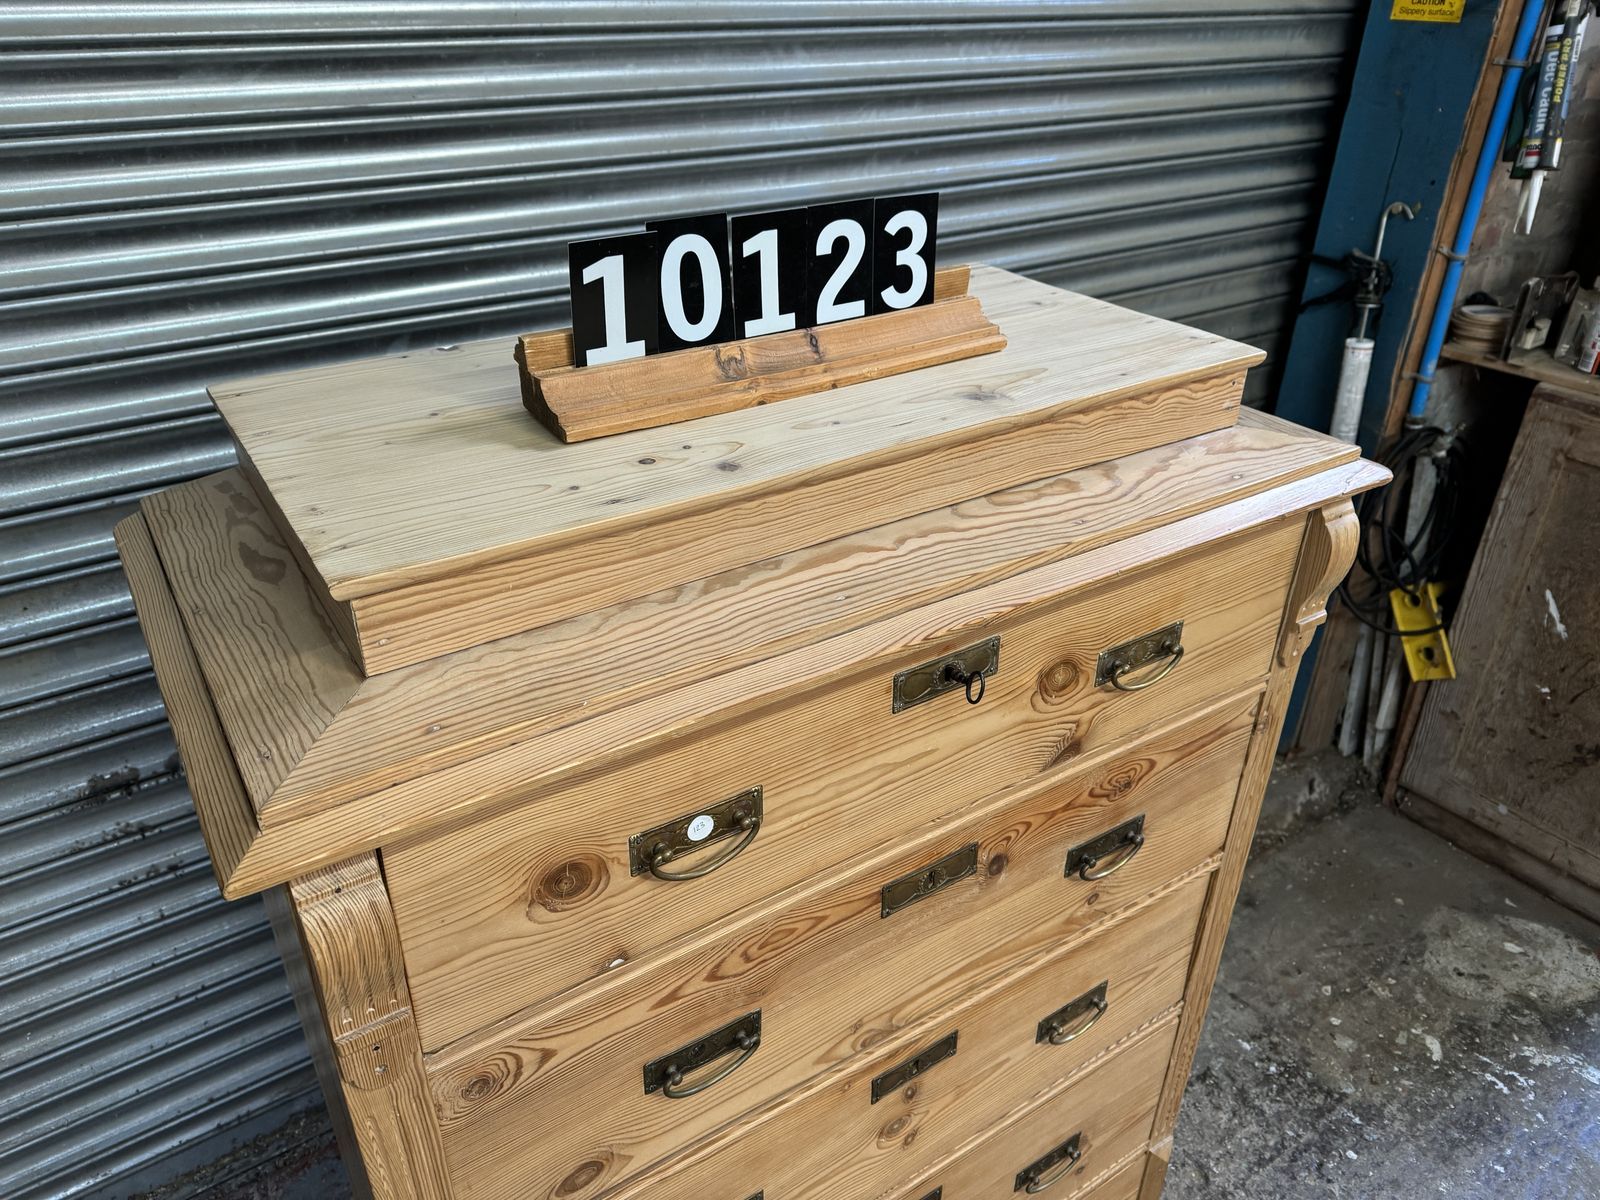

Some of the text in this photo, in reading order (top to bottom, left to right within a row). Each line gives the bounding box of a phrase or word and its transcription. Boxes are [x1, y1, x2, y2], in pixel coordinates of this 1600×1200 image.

[1399, 6, 1456, 16] Slippery surface
[1560, 37, 1573, 61] PRO
[1553, 63, 1569, 103] POWER
[582, 210, 928, 366] 10123
